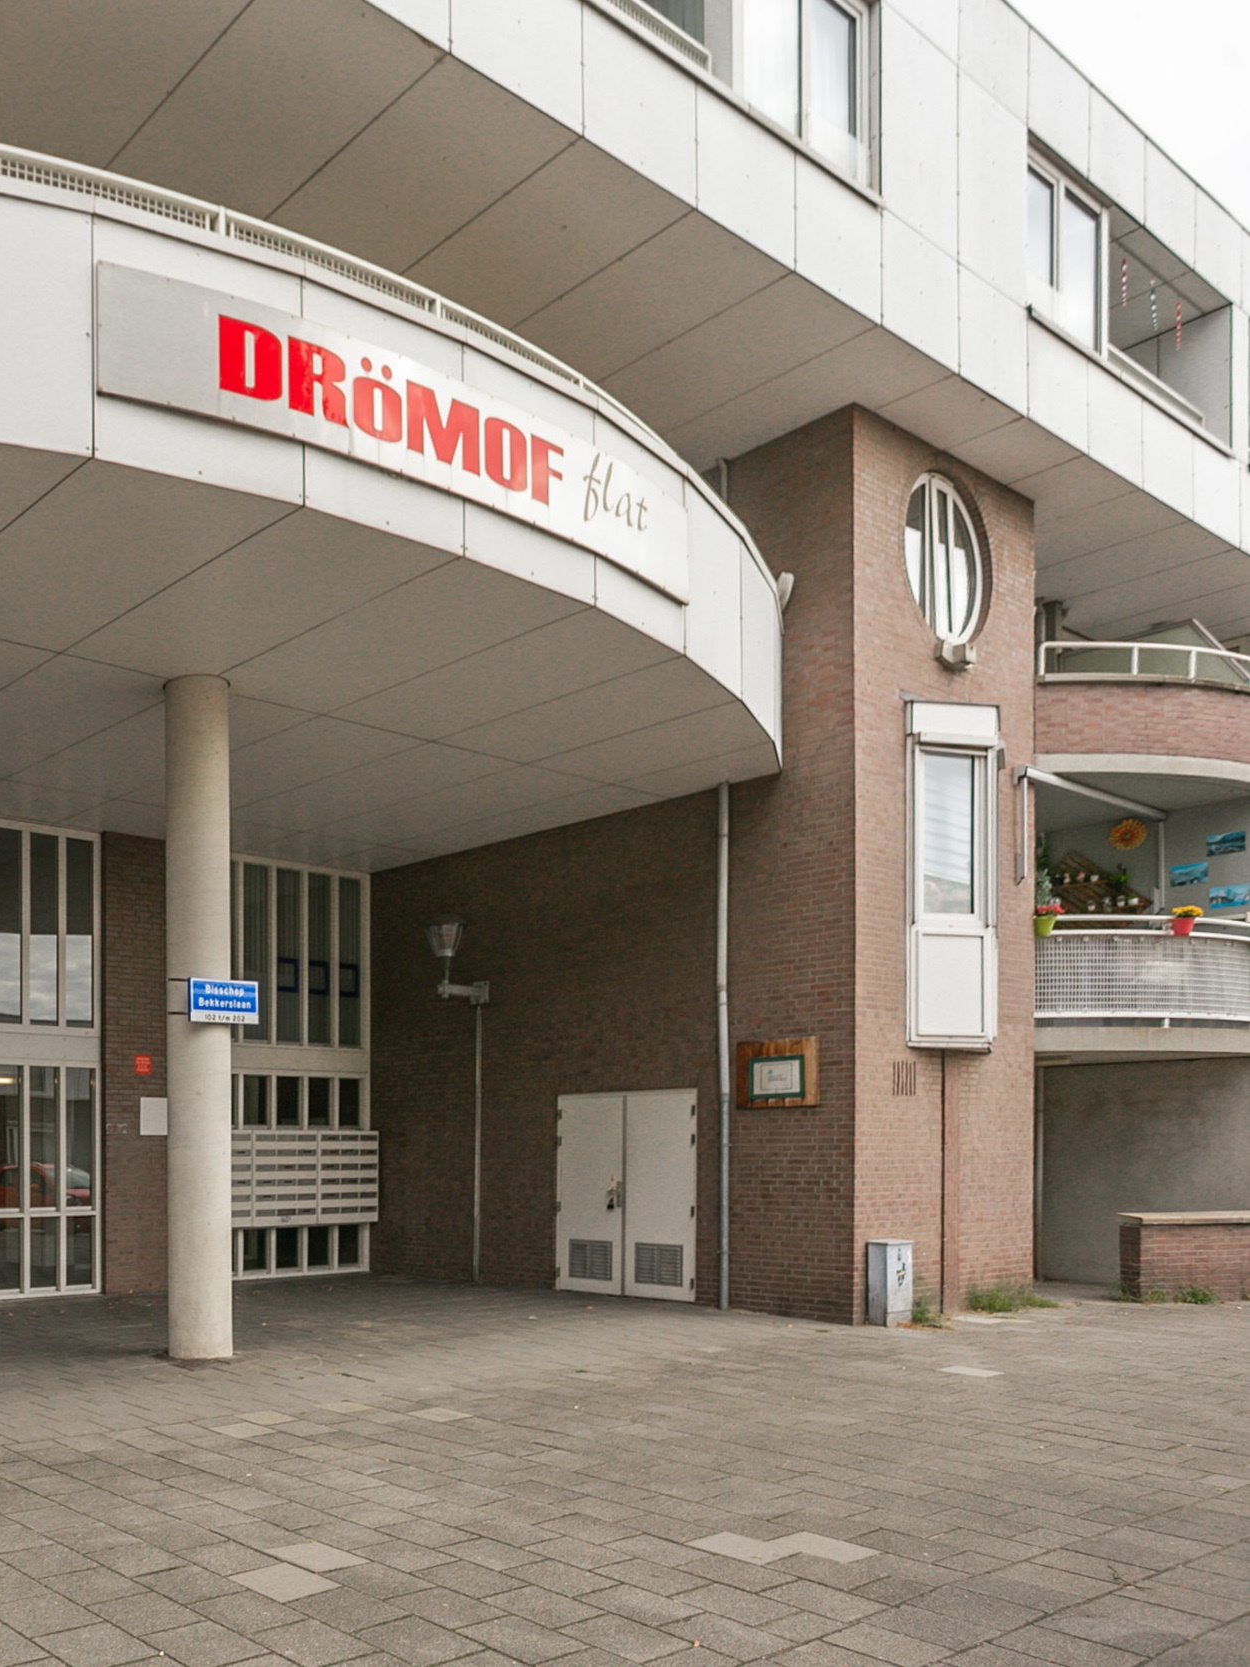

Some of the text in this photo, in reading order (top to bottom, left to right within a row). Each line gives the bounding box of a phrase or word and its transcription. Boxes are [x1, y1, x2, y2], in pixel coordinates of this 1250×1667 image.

[583, 452, 648, 531] flat
[205, 984, 244, 997] Bisschop
[198, 997, 251, 1009] Bekkerslaan
